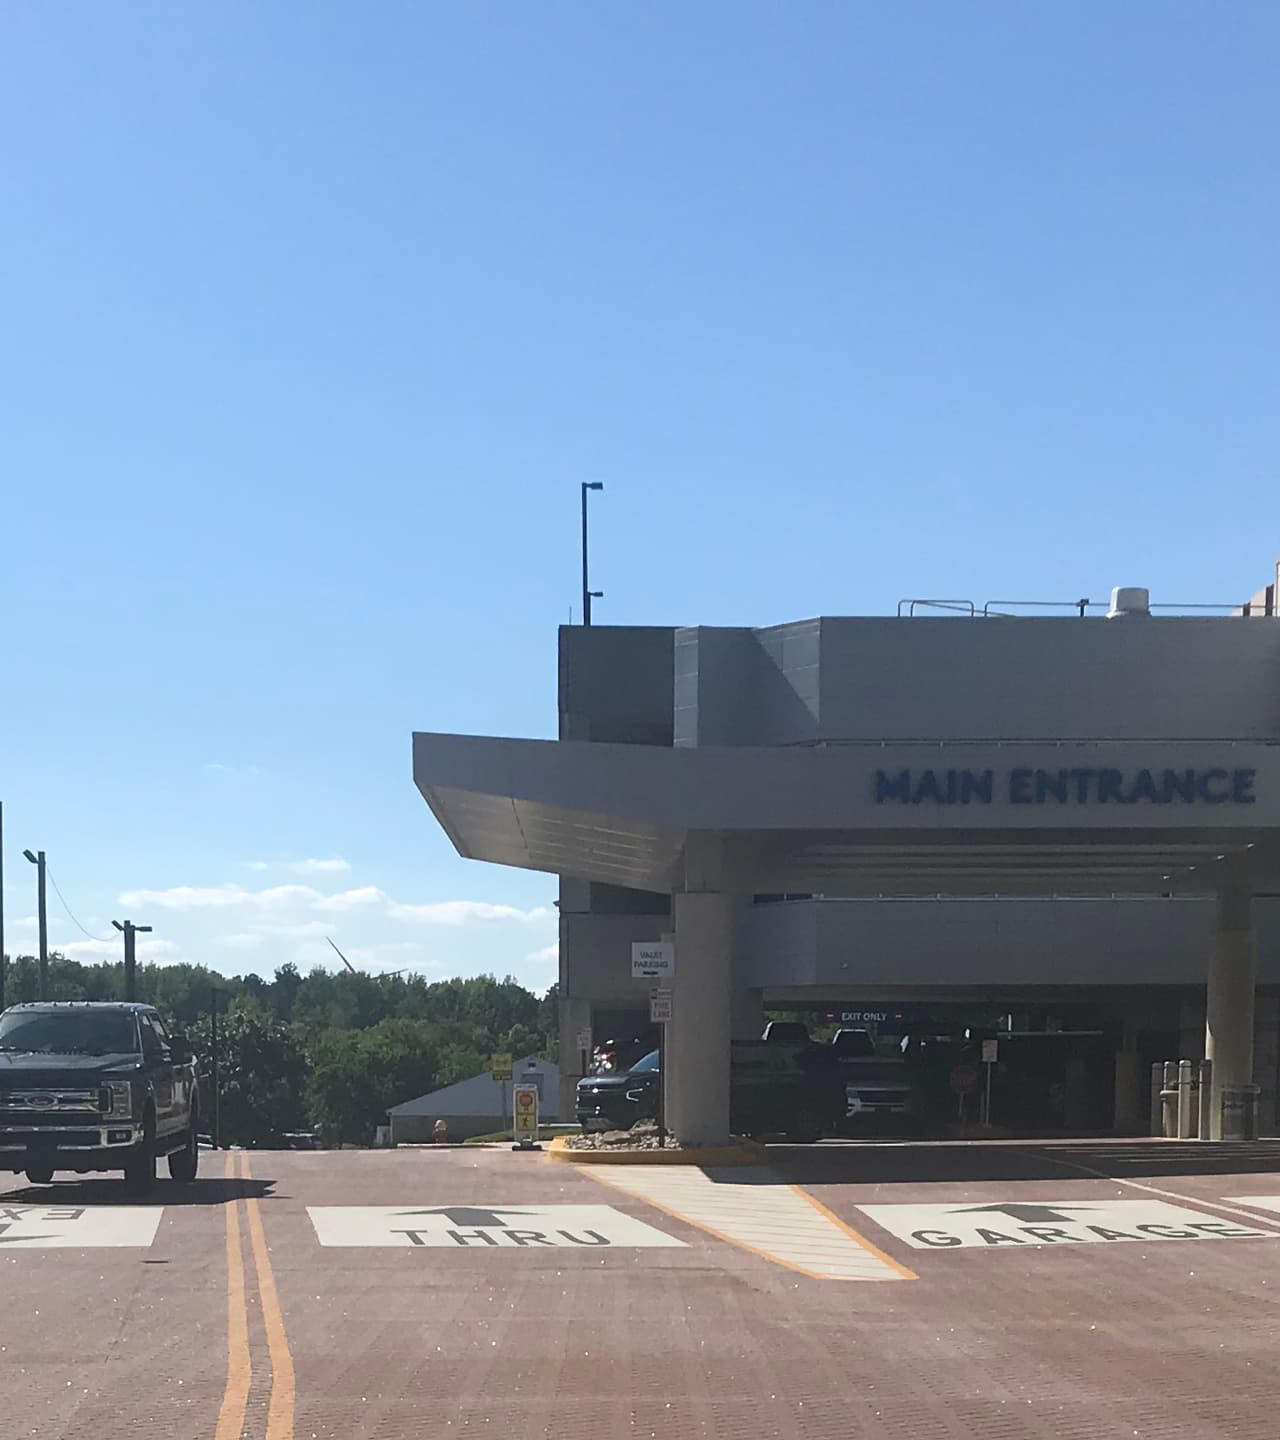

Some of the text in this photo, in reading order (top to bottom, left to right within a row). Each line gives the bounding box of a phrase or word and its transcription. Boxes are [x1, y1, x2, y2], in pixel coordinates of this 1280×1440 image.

[875, 768, 1257, 803] MAIN ENTRANCE
[633, 960, 669, 969] PARKING
[841, 1012, 887, 1021] EXIT ONLY
[390, 1229, 612, 1246] THRU
[911, 1223, 1266, 1246] GARAGE
